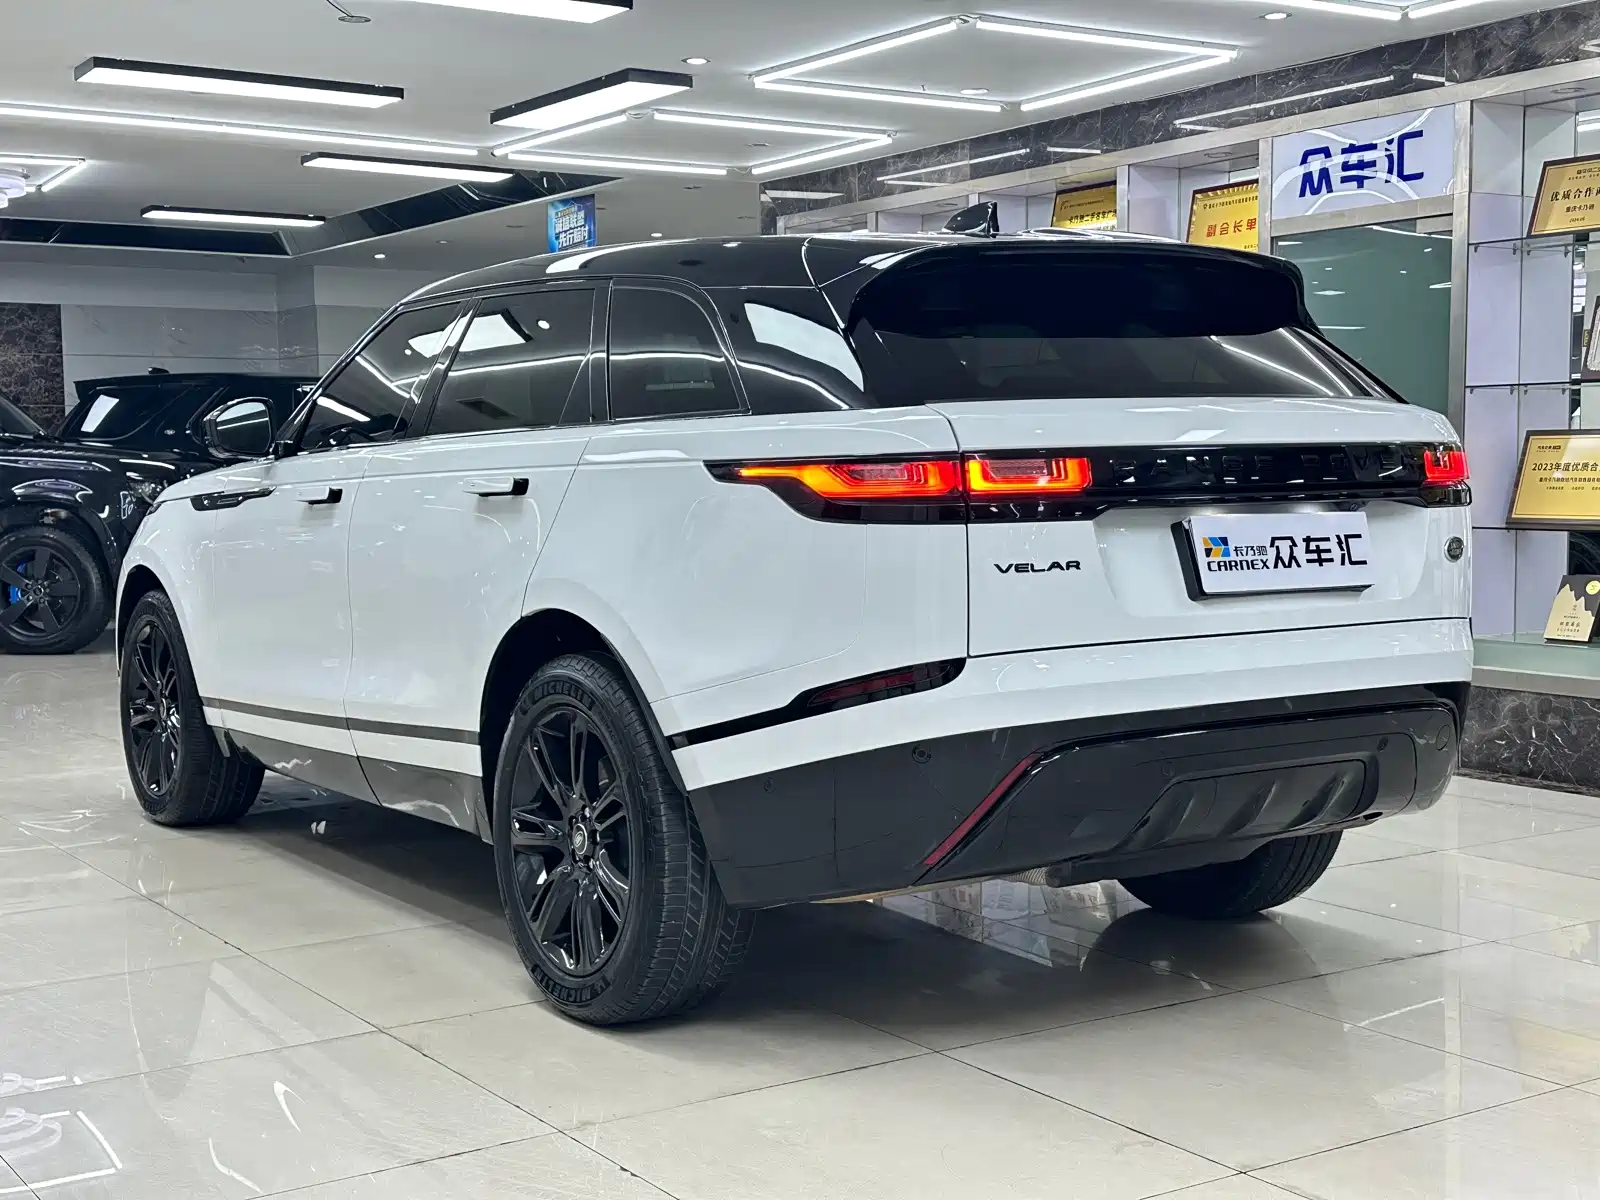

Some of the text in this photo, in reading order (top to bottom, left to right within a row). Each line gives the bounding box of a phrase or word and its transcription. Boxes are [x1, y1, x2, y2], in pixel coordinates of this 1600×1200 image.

[1298, 129, 1424, 198] 众车汇
[1532, 461, 1600, 472] 2023年度优质合
[1269, 533, 1368, 569] 众车汇
[993, 559, 1082, 575] VELAR
